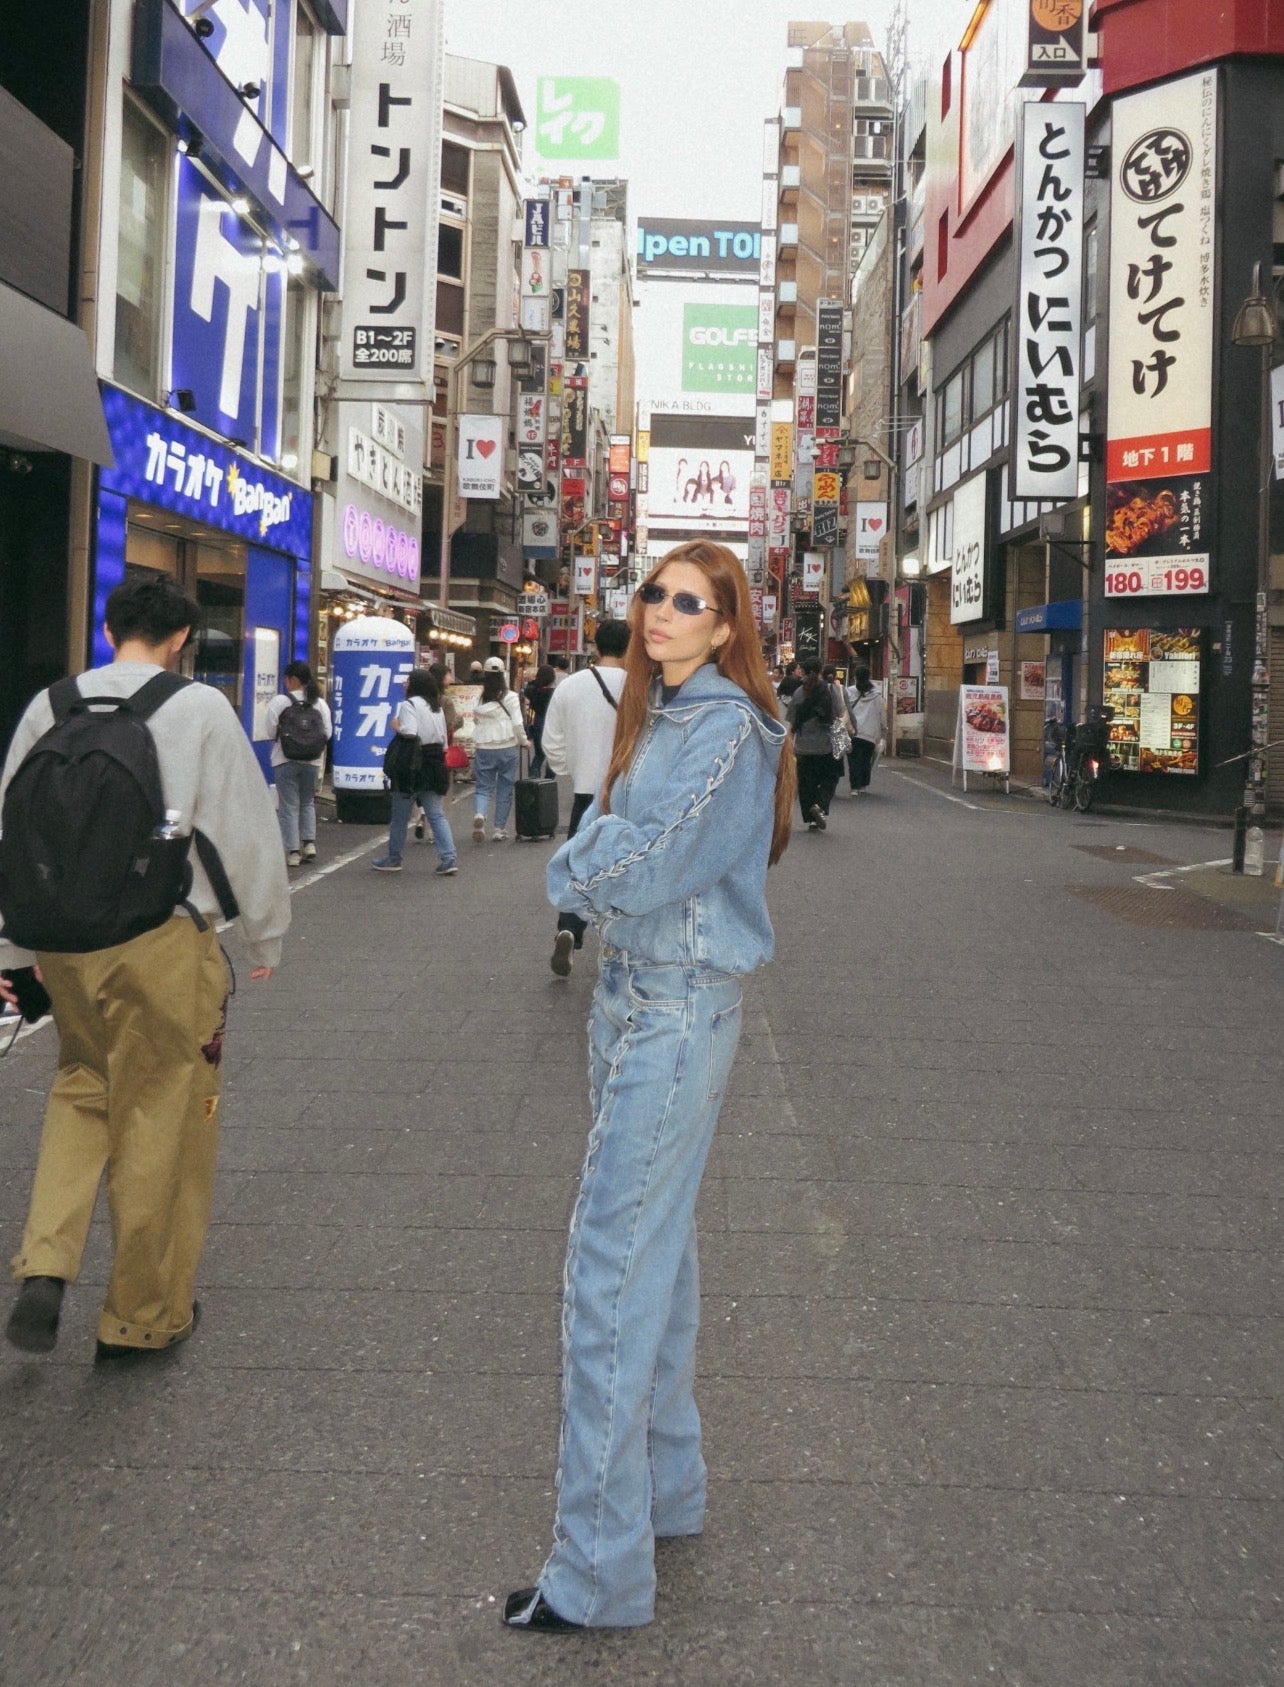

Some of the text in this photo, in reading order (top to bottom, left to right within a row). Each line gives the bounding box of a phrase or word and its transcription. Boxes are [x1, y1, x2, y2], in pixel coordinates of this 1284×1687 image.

[380, 0, 412, 67] 酒場
[1038, 46, 1066, 59] 入口
[540, 80, 606, 145] レイク
[367, 83, 412, 315] トントン
[1025, 122, 1076, 474] とんかつ にいむら
[1126, 202, 1185, 399] てけてけ
[355, 348, 412, 364] 全200席
[683, 401, 711, 411] BLDG
[466, 439, 476, 459] I
[1122, 443, 1194, 467] 地下1階
[145, 432, 291, 527] カラオケ BanBan
[462, 482, 495, 492] 歌舞伎町
[861, 518, 867, 532] I
[1179, 490, 1191, 551] 本気の一本。
[806, 563, 811, 574] I
[955, 541, 980, 575] とんかつ
[953, 575, 982, 608] にいむら
[346, 639, 378, 647] カラオケ
[334, 676, 343, 741] カラオケ
[355, 702, 401, 737] オ
[344, 773, 376, 782] カラオケ
